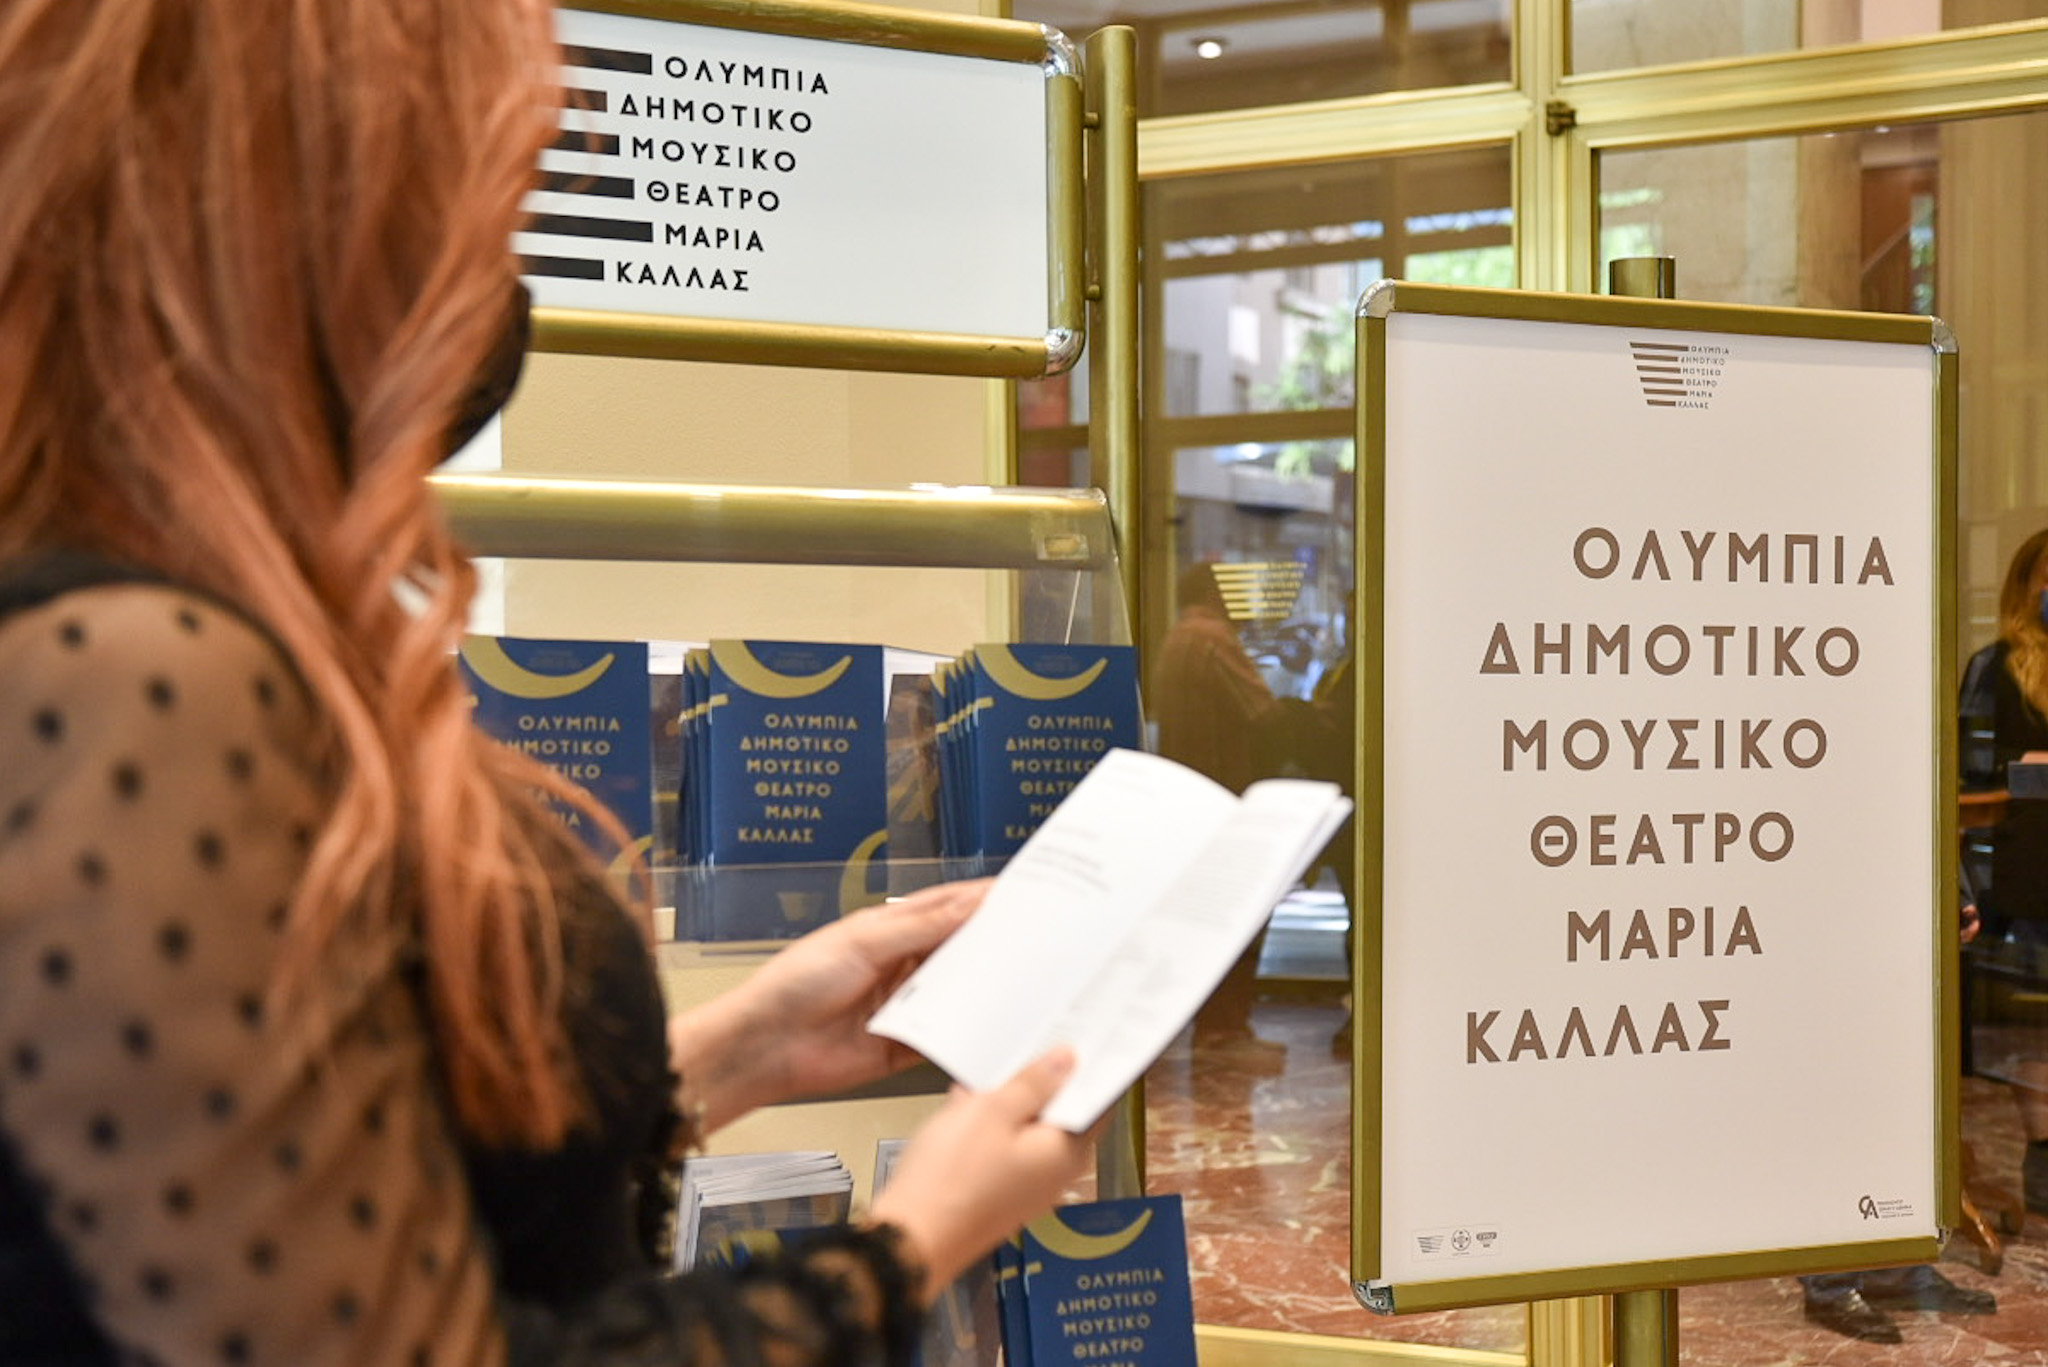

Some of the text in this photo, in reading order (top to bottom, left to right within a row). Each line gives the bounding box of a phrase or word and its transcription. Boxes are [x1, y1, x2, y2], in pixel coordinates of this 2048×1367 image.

[664, 55, 829, 95] ΟΛΥΜΠΙΑ
[619, 93, 812, 134] ΔΗΜΟΤΙΚΟ
[632, 136, 796, 172] ΜΟΥΣΙΚΟ
[646, 180, 780, 212] ΘΕΑΤΡΟ
[665, 223, 764, 252] ΜΑΡΙΑ
[616, 261, 749, 291] ΚΑΛΛΑΣ
[1573, 527, 1895, 586] ΟΛΥΜΠΙΑ
[1479, 622, 1860, 677] ΔΗΜΟΤΙΚΟ
[518, 715, 621, 732] ΟΛΥΜΠΙΑ
[764, 713, 858, 731] ΟΛΥΜΠΙΑ
[1028, 715, 1113, 731] ΟΛΥΜΠΙΑ
[507, 739, 611, 756] ΗΜΟΤΙΚΟ
[740, 736, 849, 753] ΔΗΜΟΤΙΚΟ
[1006, 737, 1105, 752] ΔΗΜΟΤΙΚΟ
[1503, 718, 1828, 771] ΜΟΥΣΙΚΟ
[746, 759, 841, 775] ΜΟΥΣΙΚΟ
[755, 782, 832, 798] ΘΕΑΤΡΟ
[1019, 780, 1076, 795] ΘΕΑΤΡ
[765, 805, 822, 819] ΜΑΡΙΑ
[737, 828, 813, 843] ΚΑΛΛΑΣ
[1530, 811, 1794, 867] ΘΕΑΤΡΟ
[1567, 905, 1763, 962] ΜΑΡΙΑ
[1466, 999, 1731, 1064] ΚΑΛΛΑΣ
[1077, 1269, 1163, 1290] ΟΛΥΜΠΙΑ
[1056, 1291, 1157, 1316] ΔΗΜΟΤΙΚΟ
[1063, 1314, 1150, 1337] ΜΟΥΣΙΚΟ
[1073, 1336, 1144, 1359] ΘΕΑΤΡΟ
